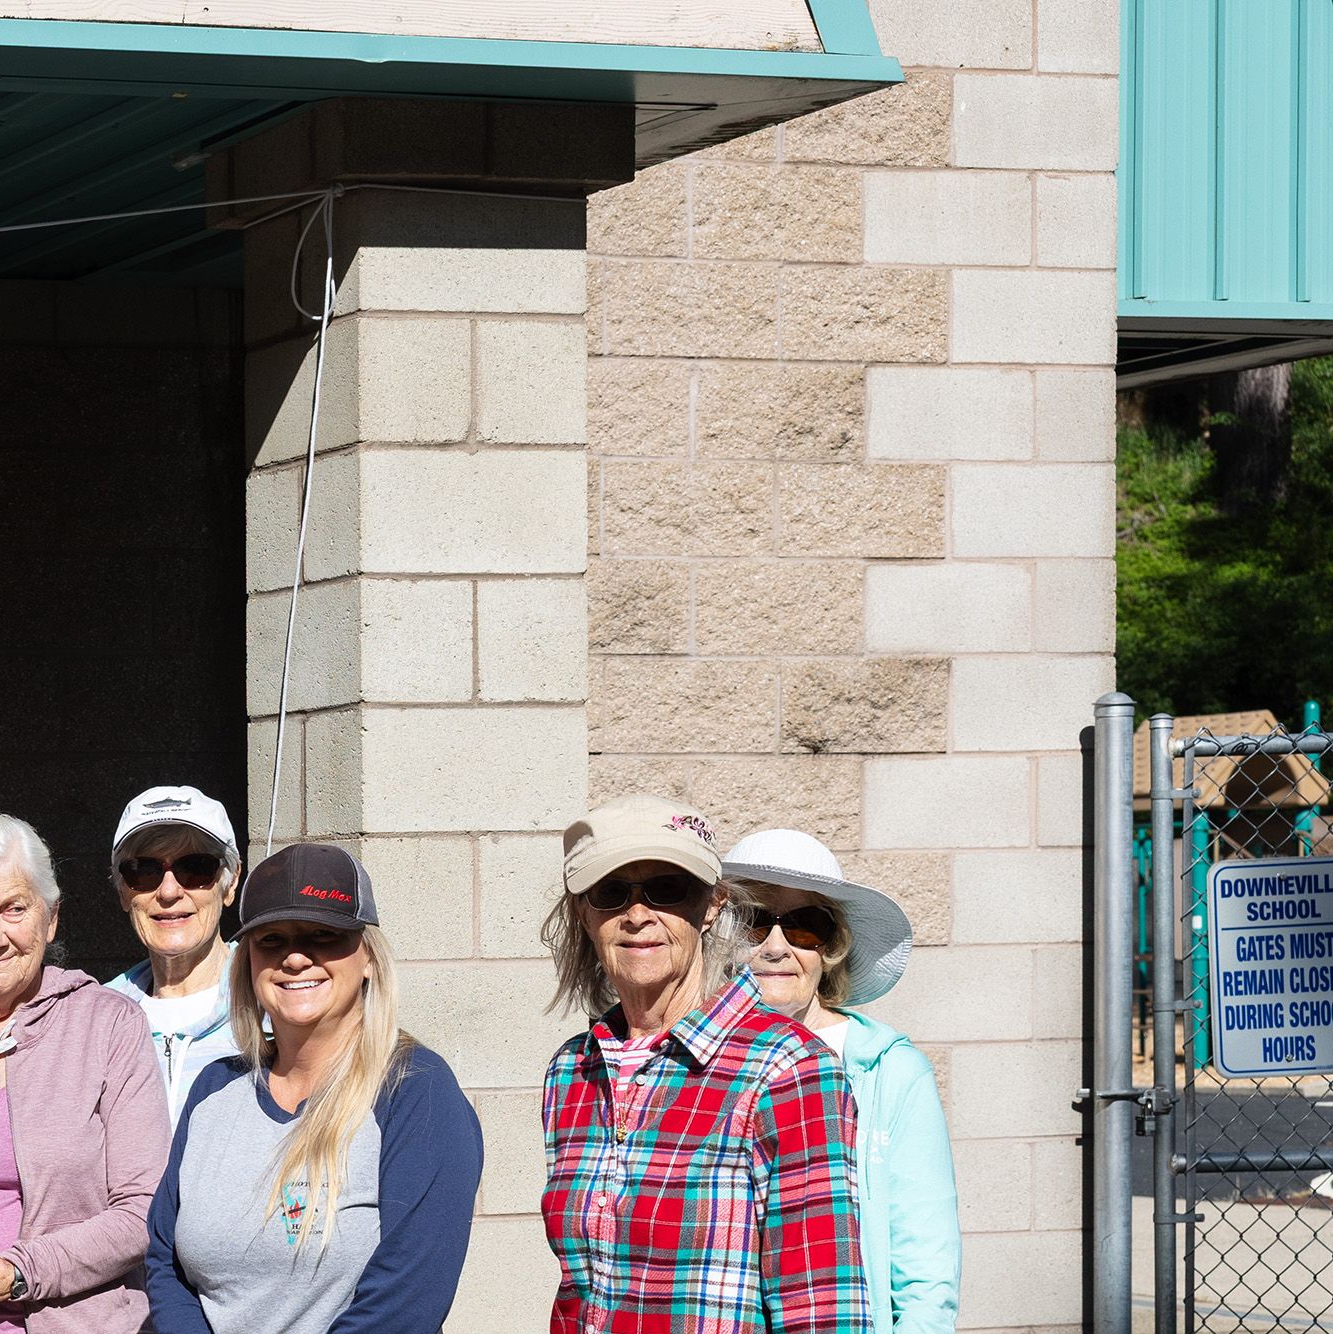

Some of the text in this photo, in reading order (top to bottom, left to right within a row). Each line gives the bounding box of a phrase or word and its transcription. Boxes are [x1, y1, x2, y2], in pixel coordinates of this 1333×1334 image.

[1247, 899, 1321, 921] SCHOOL
[1237, 931, 1333, 962] GATES MUST
[1223, 969, 1284, 996] REMAIN
[1225, 1000, 1333, 1030] DURING SCHO
[1263, 1035, 1316, 1062] HOURS
